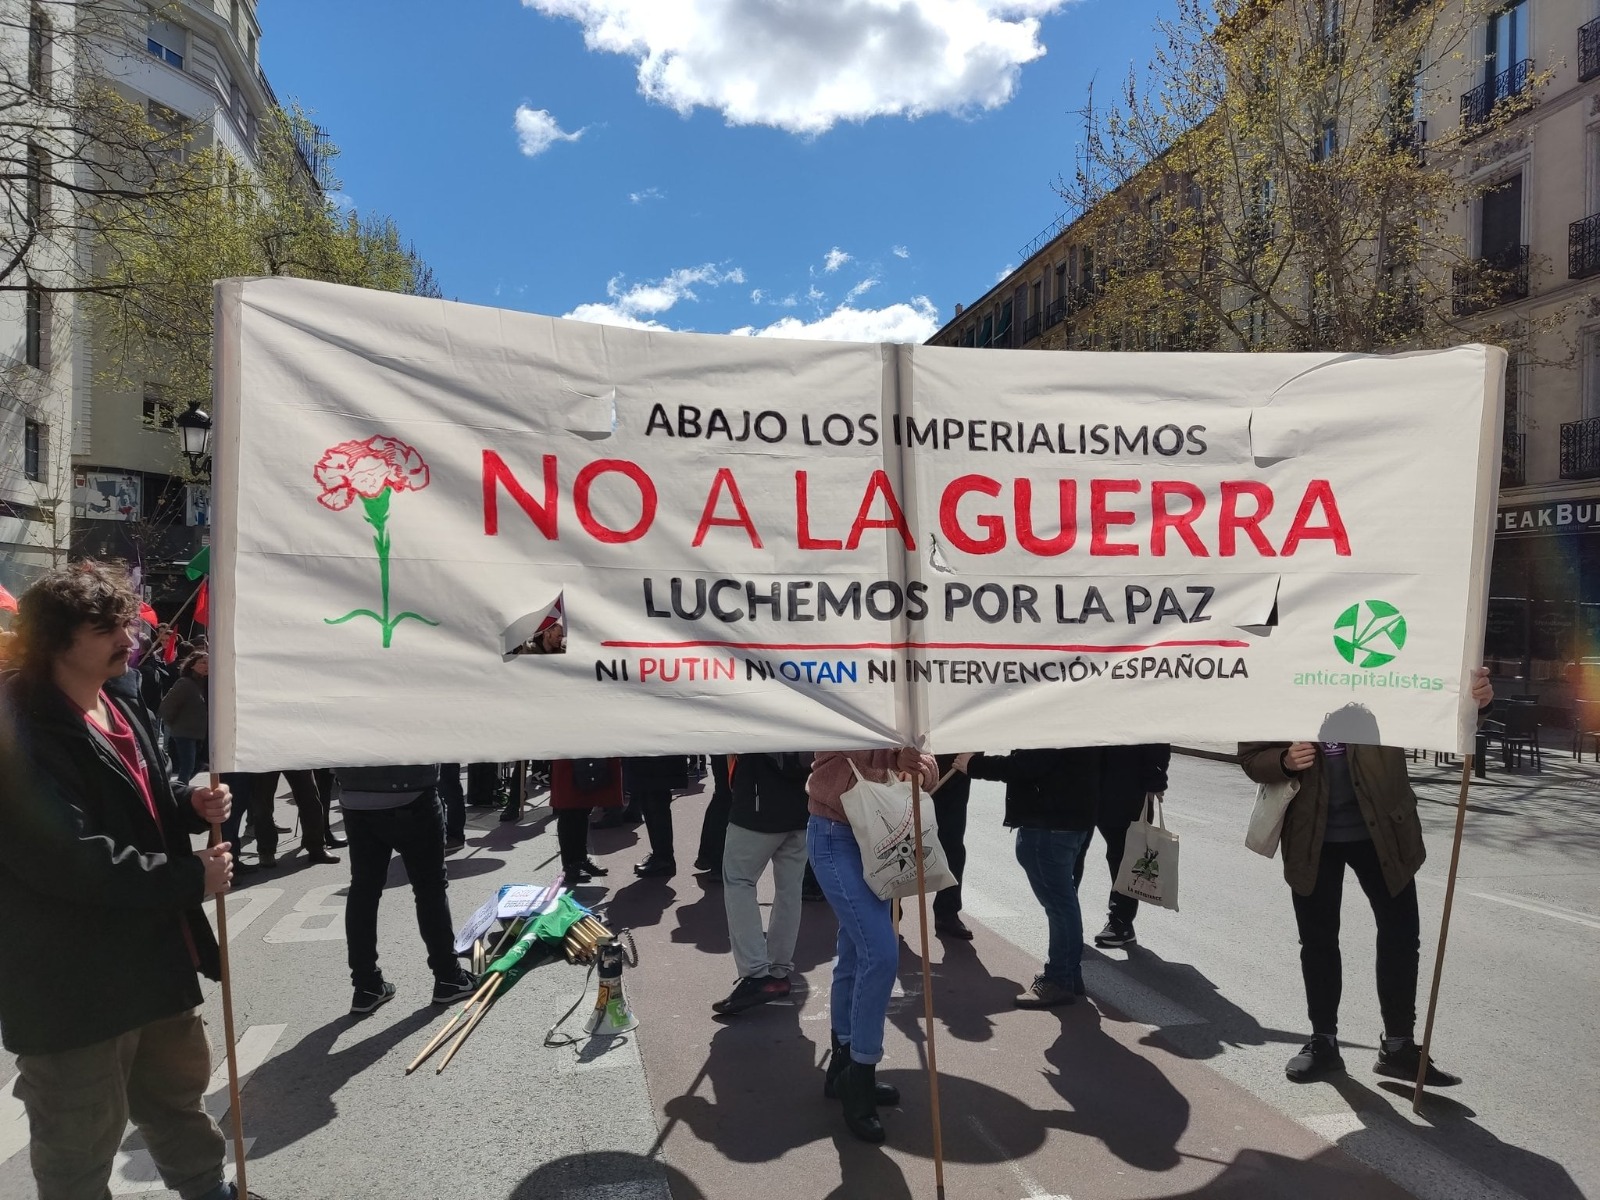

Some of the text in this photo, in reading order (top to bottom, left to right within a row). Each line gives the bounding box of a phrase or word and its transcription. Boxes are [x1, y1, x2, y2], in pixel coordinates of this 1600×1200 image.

[645, 403, 1207, 457] ABAJO LOS IMPERIALISMOS
[482, 449, 1352, 557] NO A LA GUERRA
[643, 577, 1216, 625] LUCHEMOS POR LA PAZ
[595, 659, 629, 683] NI
[639, 657, 735, 683] PUTIN
[745, 659, 776, 682] NI
[778, 660, 858, 685] OTAN
[867, 659, 897, 684] NI
[1110, 653, 1249, 681] ESPAÑOLA
[1293, 669, 1444, 692] anticapitalistas
